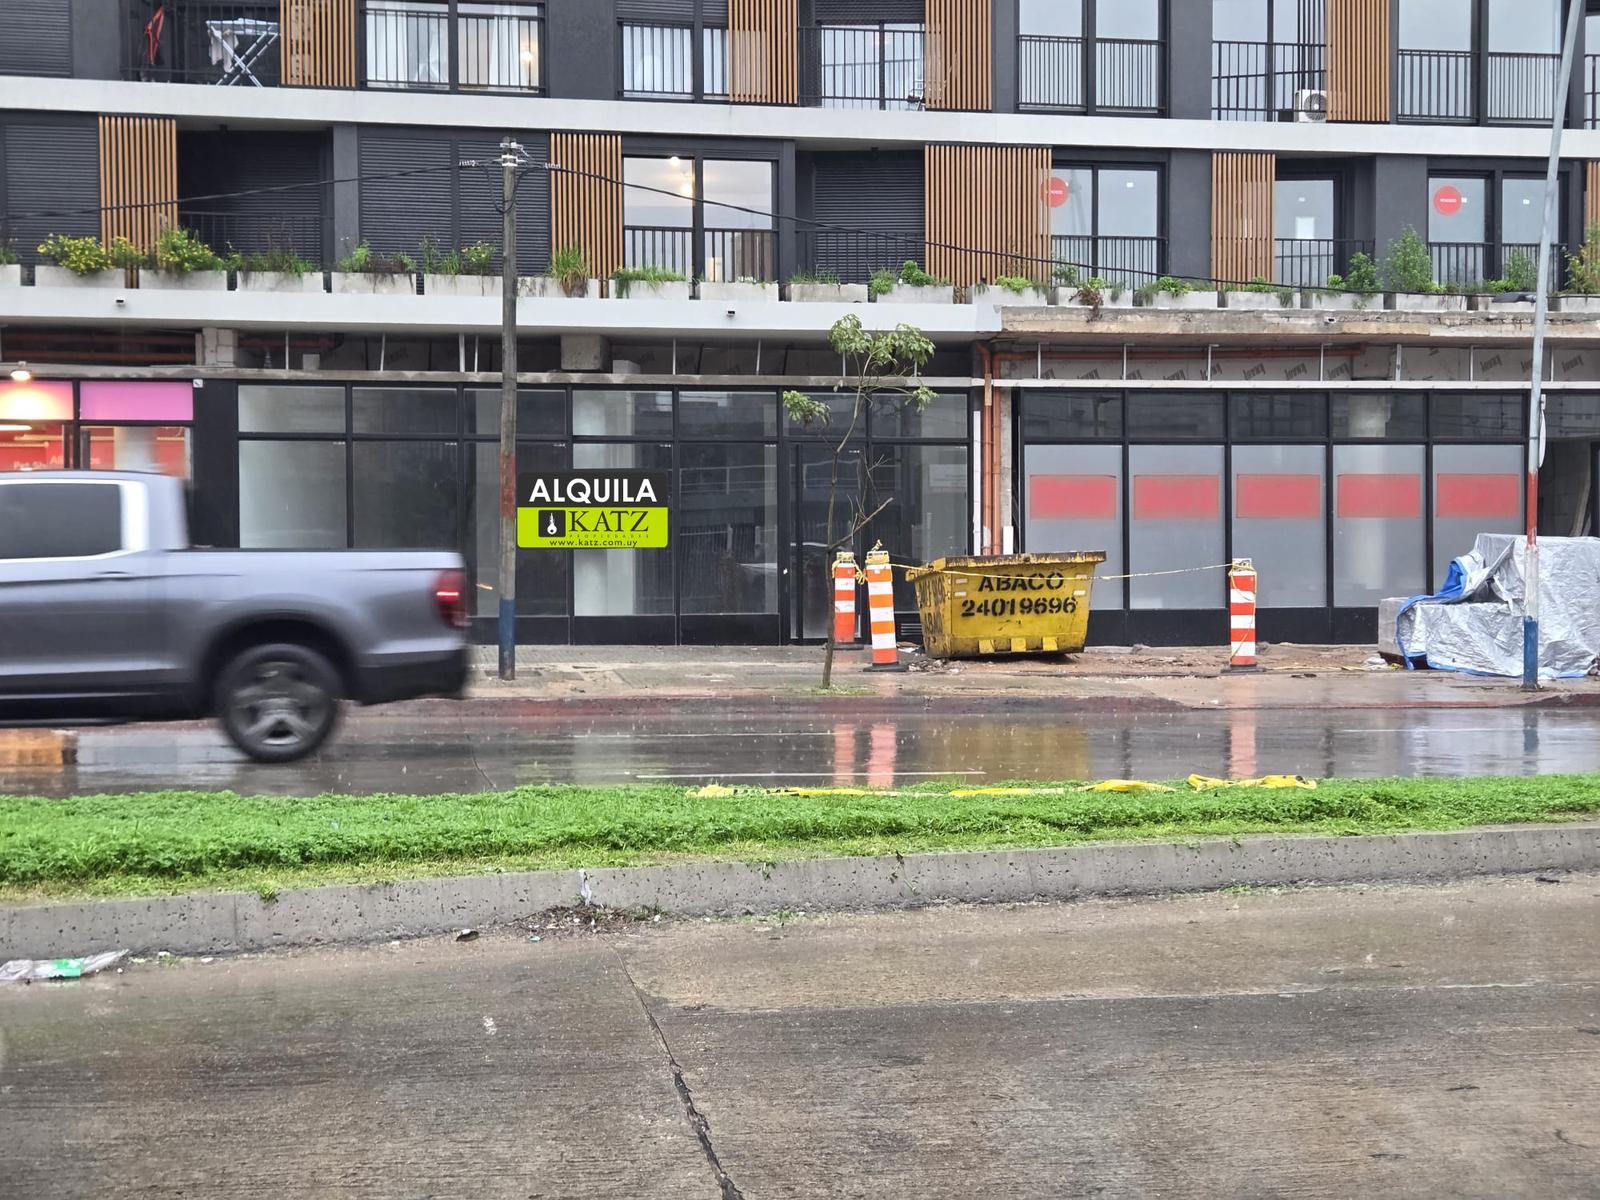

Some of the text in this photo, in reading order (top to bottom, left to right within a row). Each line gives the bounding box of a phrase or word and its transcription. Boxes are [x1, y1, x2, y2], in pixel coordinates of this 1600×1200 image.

[529, 478, 657, 504] ALQUILA
[568, 510, 649, 532] KATZ
[549, 539, 638, 548] www.katz.com.uy
[978, 572, 1064, 592] ABACO
[961, 597, 1077, 617] 24019696
